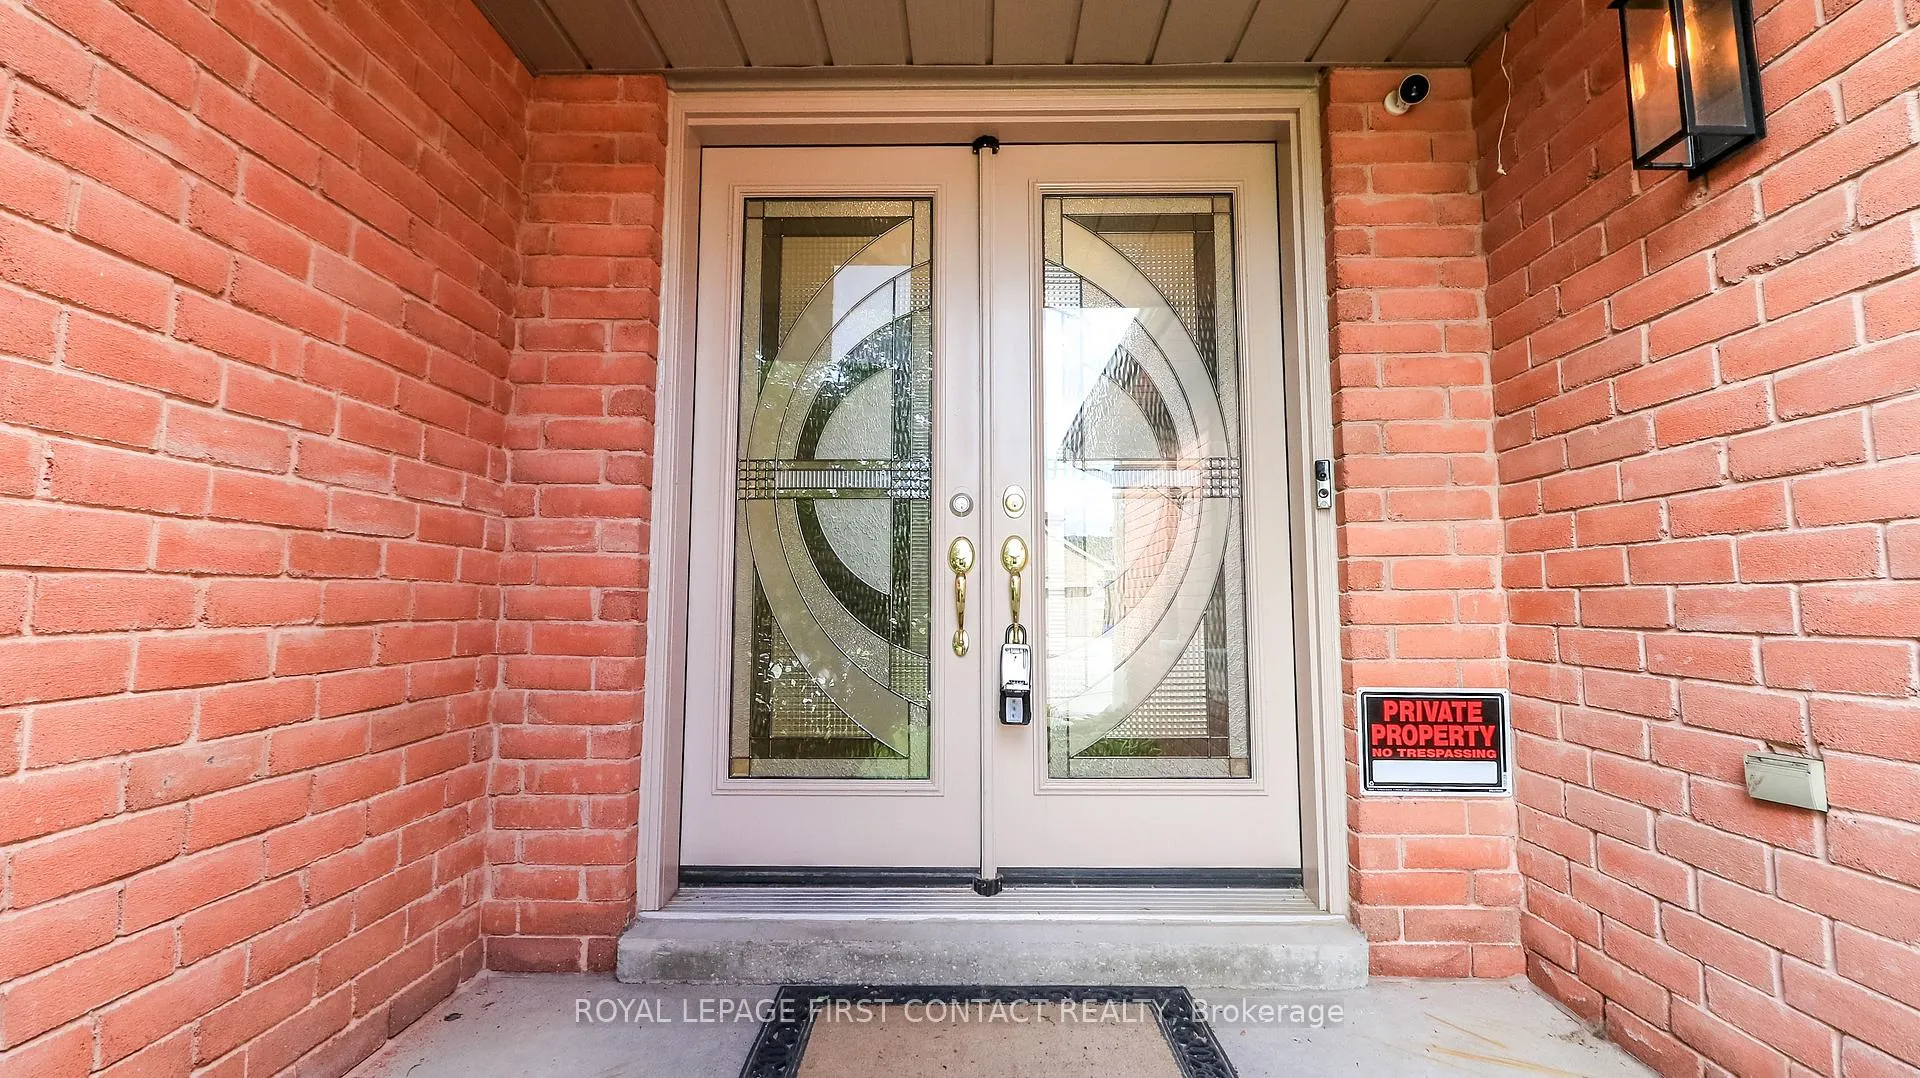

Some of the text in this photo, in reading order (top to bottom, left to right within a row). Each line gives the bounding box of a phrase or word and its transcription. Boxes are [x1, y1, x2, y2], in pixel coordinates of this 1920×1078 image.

[1383, 700, 1483, 723] PRIVATE
[1371, 724, 1496, 747] PROPERTY
[1372, 748, 1497, 759] NO TRESPASSING
